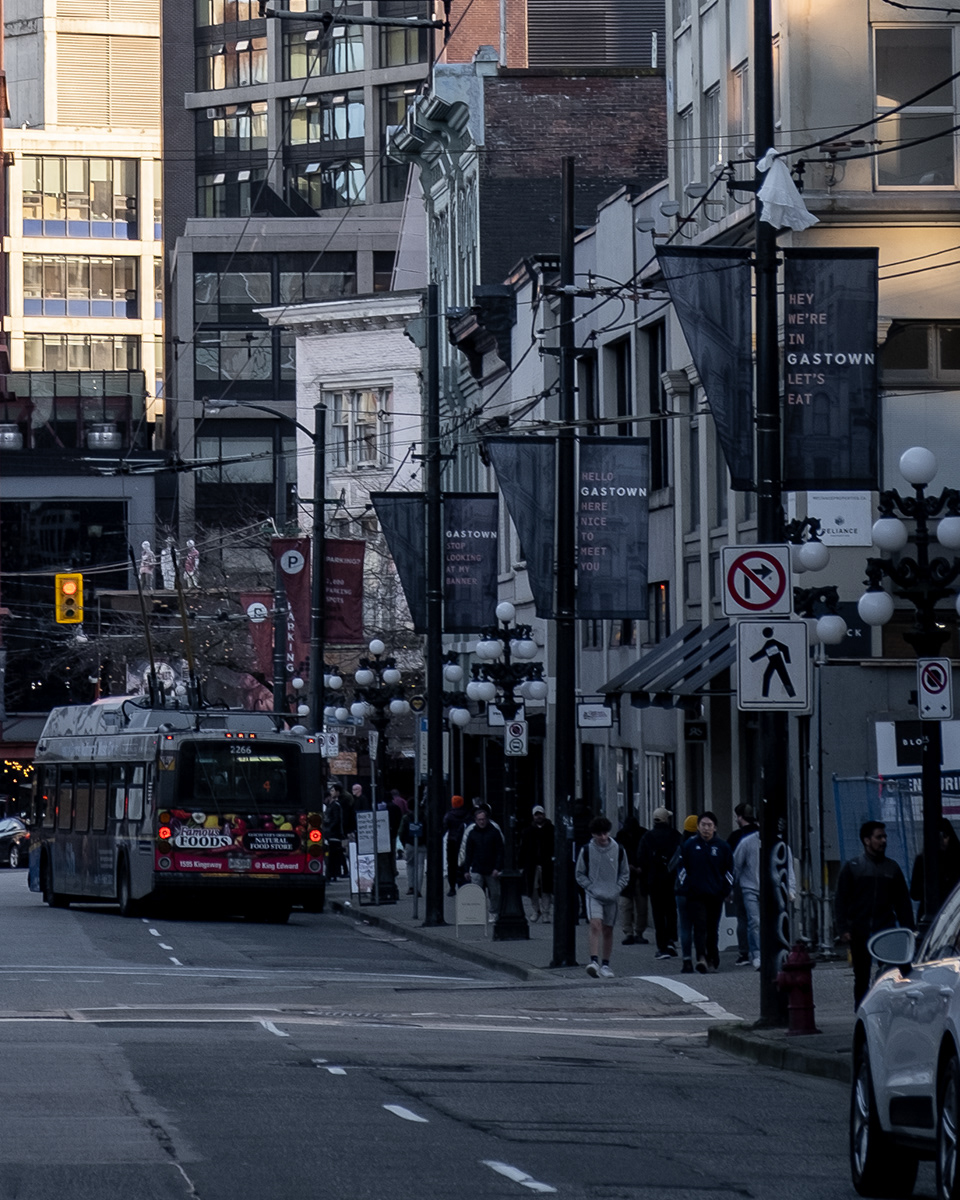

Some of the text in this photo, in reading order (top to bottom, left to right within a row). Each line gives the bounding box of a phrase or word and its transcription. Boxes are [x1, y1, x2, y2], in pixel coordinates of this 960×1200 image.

[789, 293, 814, 305] HEY
[788, 313, 827, 325] WE'RE
[788, 333, 804, 345] IN
[787, 353, 875, 365] GASTOWN
[788, 373, 825, 384] LET'S
[788, 393, 812, 405] EAT
[581, 472, 614, 481] HELLO
[581, 487, 647, 497] GASTOWN
[581, 502, 607, 511] HERE
[581, 517, 607, 526] NICE
[446, 530, 497, 539] GASTOWN
[581, 532, 594, 541] TO
[446, 542, 465, 550] STOP
[581, 547, 607, 556] MEET
[288, 556, 298, 568] P
[446, 554, 482, 562] LOOKING
[581, 562, 599, 571] YOU
[446, 577, 478, 585] BANNER
[230, 745, 252, 755] 2266
[181, 825, 220, 837] Famous
[180, 836, 228, 846] FOODS
[193, 860, 222, 870] Kingsway
[261, 862, 275, 871] King
[276, 862, 299, 870] Edward
